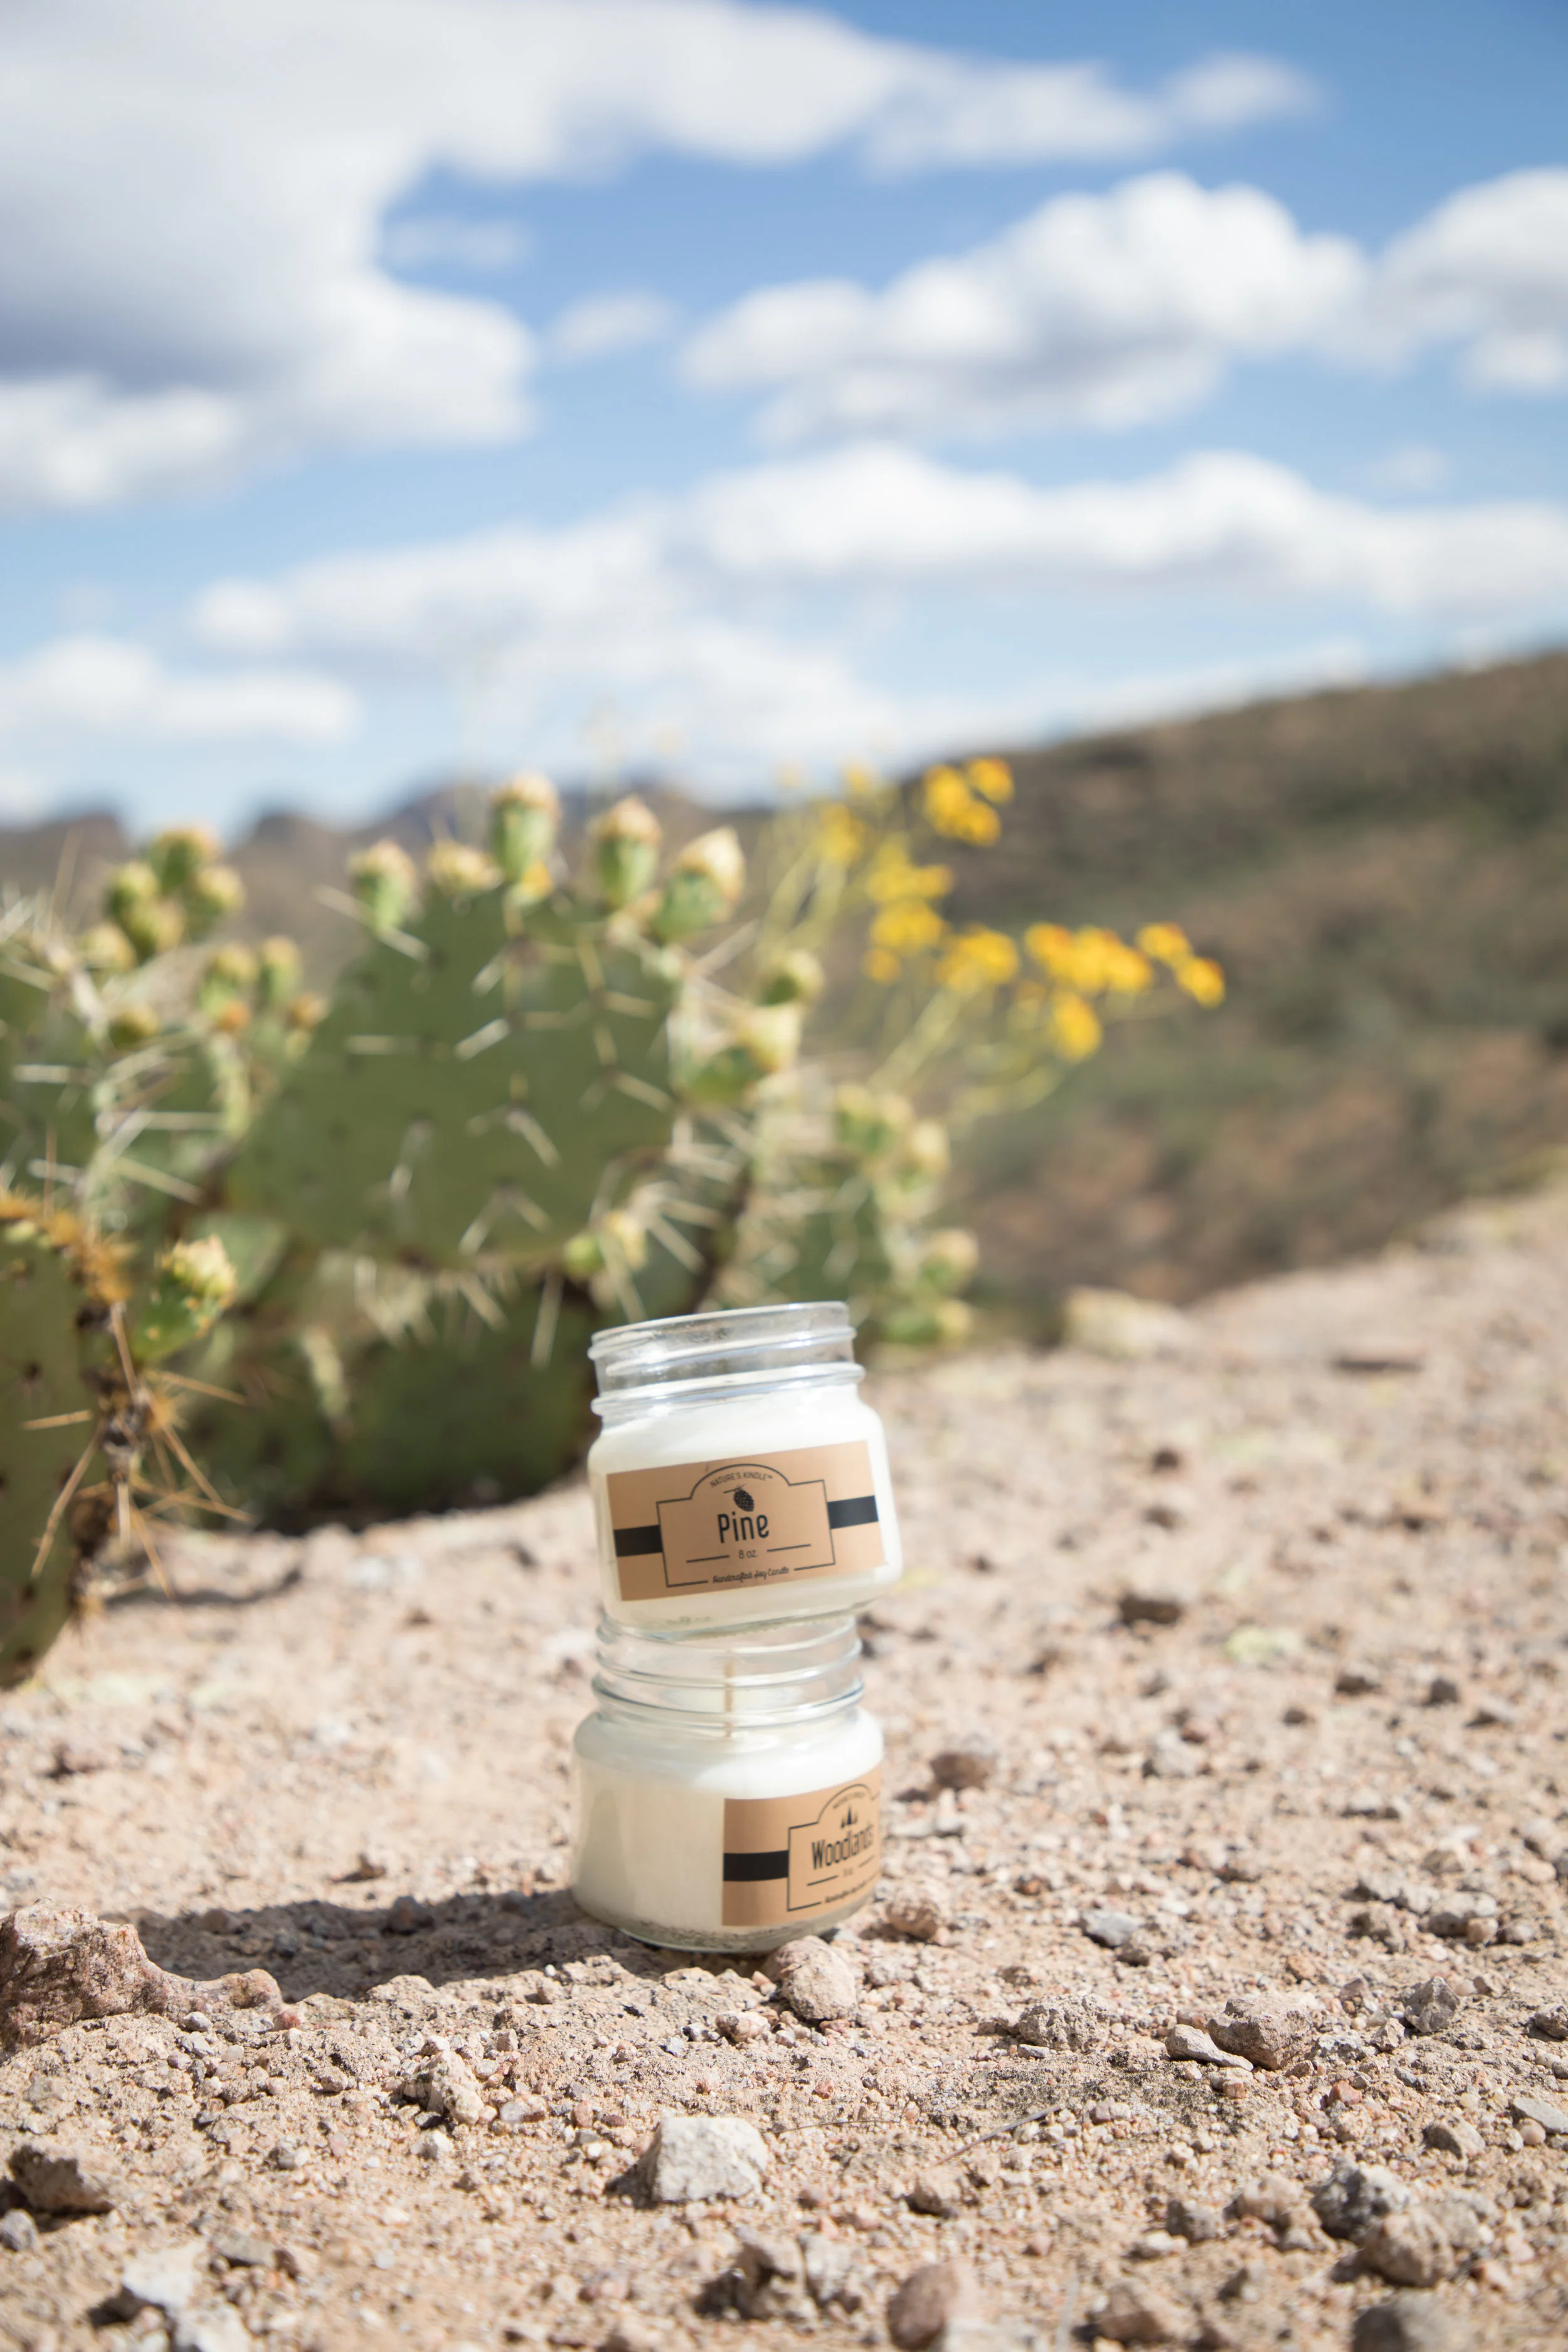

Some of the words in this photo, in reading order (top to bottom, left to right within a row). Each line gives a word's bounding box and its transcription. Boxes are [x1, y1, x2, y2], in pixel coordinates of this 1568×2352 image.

[710, 1471, 741, 1488] NATURE'S
[718, 1511, 769, 1544] Pine
[738, 1549, 744, 1559] 8
[712, 1572, 752, 1583] Handcrafted
[754, 1570, 766, 1580] Soy
[767, 1566, 789, 1576] Candle
[812, 1821, 874, 1870] Woodlands
